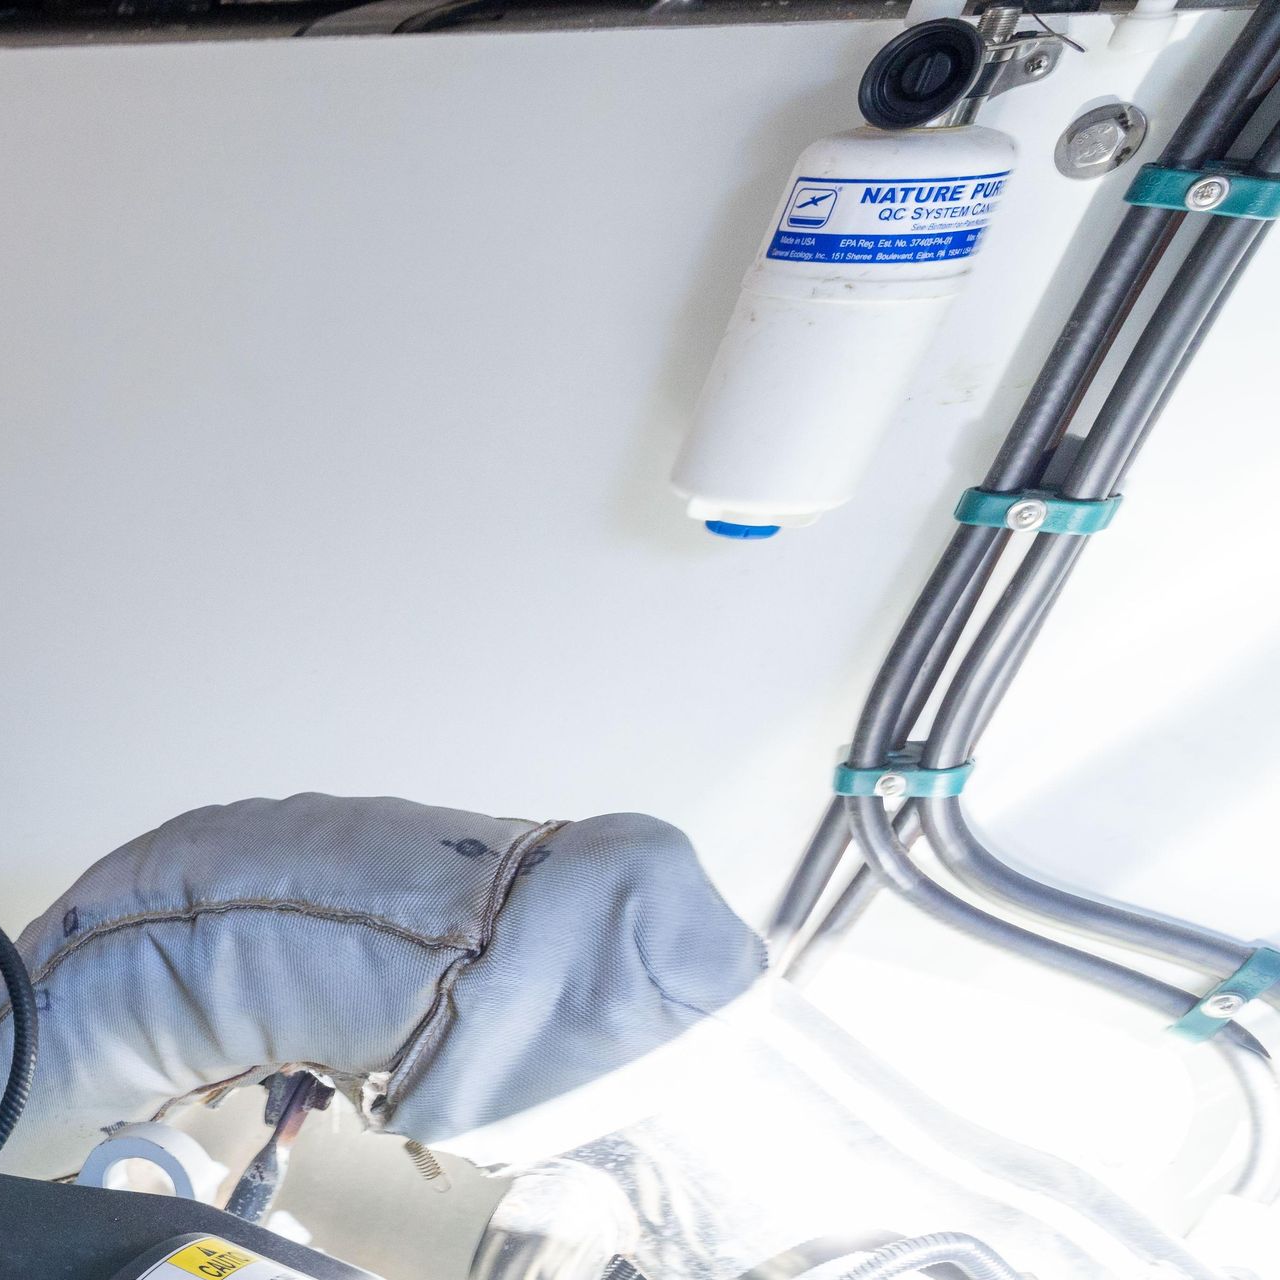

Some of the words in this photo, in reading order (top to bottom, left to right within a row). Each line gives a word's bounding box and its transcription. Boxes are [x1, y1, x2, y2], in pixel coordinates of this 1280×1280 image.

[860, 184, 966, 204] NATURE
[878, 207, 906, 221] QC
[911, 206, 970, 220] SYSTEM
[801, 237, 816, 246] USA
[840, 239, 857, 248] EPA
[895, 239, 907, 247] No.
[831, 252, 843, 260] 151
[846, 252, 872, 260] Sheree
